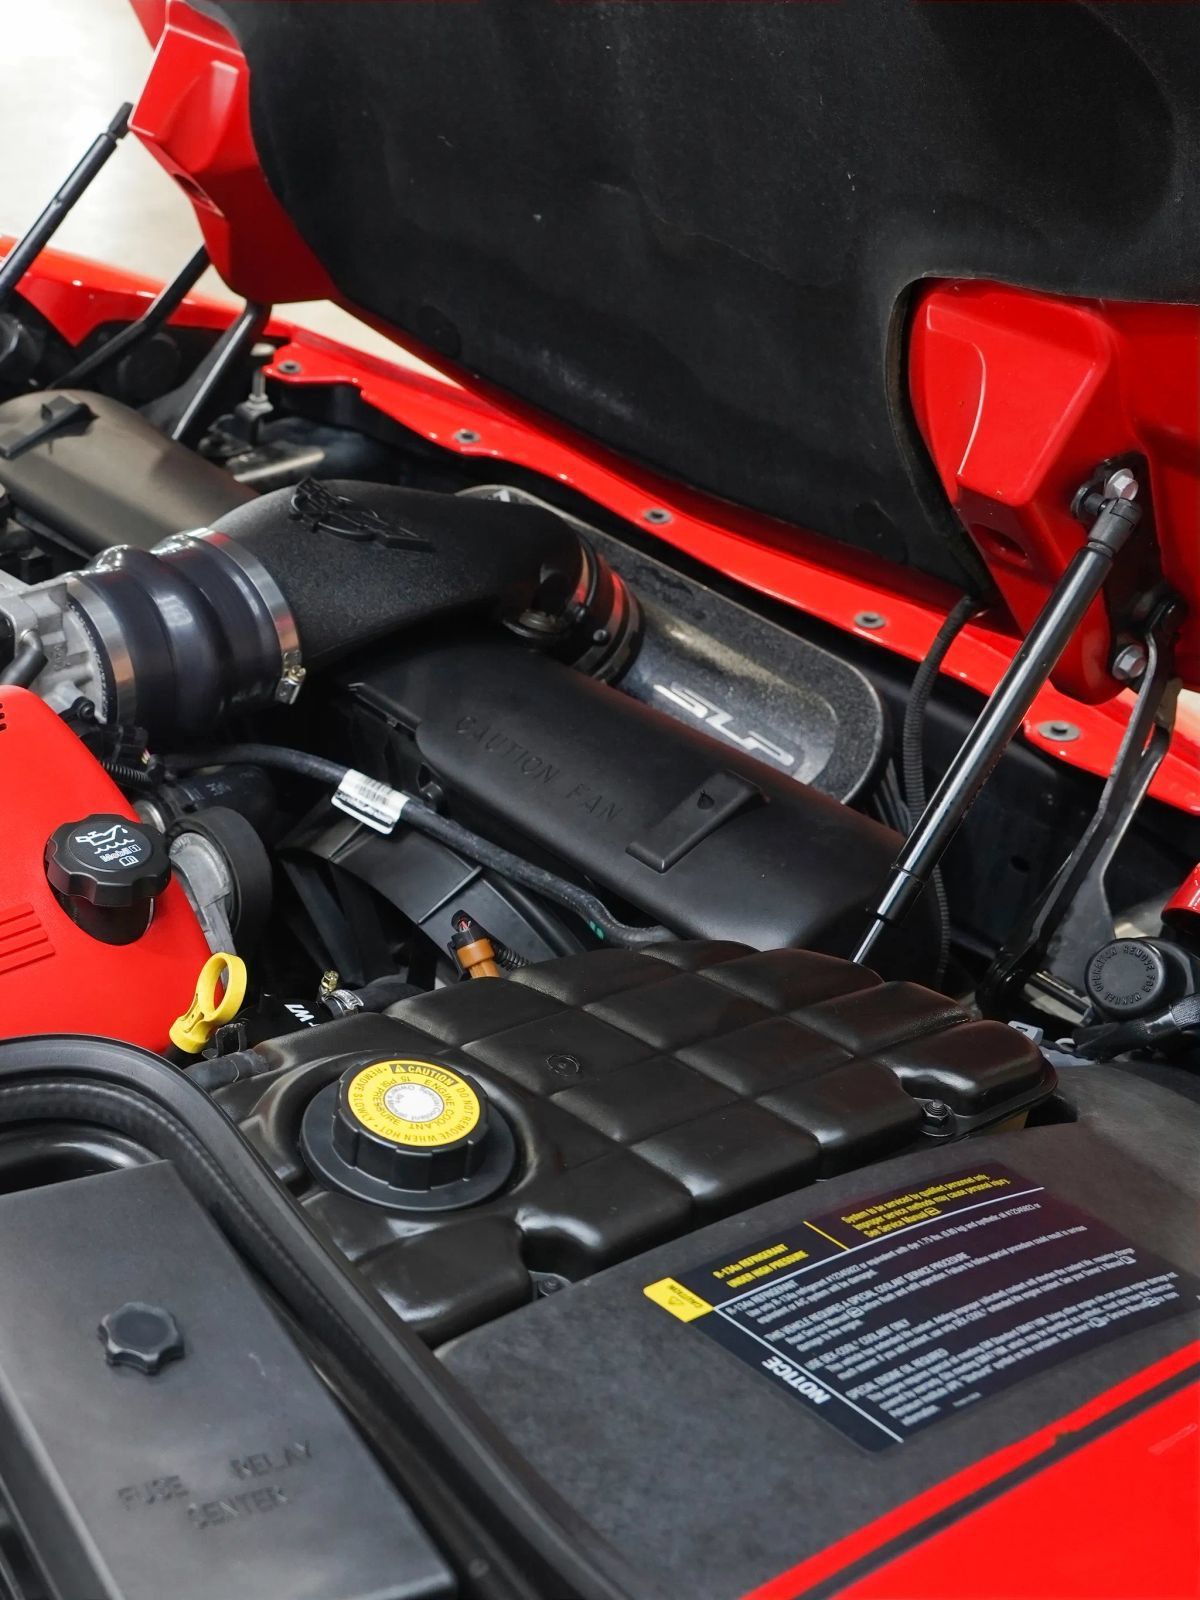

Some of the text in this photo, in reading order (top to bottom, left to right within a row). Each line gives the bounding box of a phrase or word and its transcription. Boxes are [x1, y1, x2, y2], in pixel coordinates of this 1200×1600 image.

[653, 682, 794, 766] SLP
[456, 715, 623, 823] CAUTION FAN
[408, 1065, 456, 1086] CAUTION
[379, 1088, 474, 1143] DO NOT REMOVE WHEN HOT
[408, 1079, 455, 1130] ENGINE COOLANT
[726, 1250, 809, 1287] UNDER HIGH PRESSURE
[738, 1243, 788, 1267] REFRIGERANT
[762, 1356, 831, 1404] NOTICE
[118, 1475, 190, 1511] FUSE
[187, 1485, 288, 1530] CENTER
